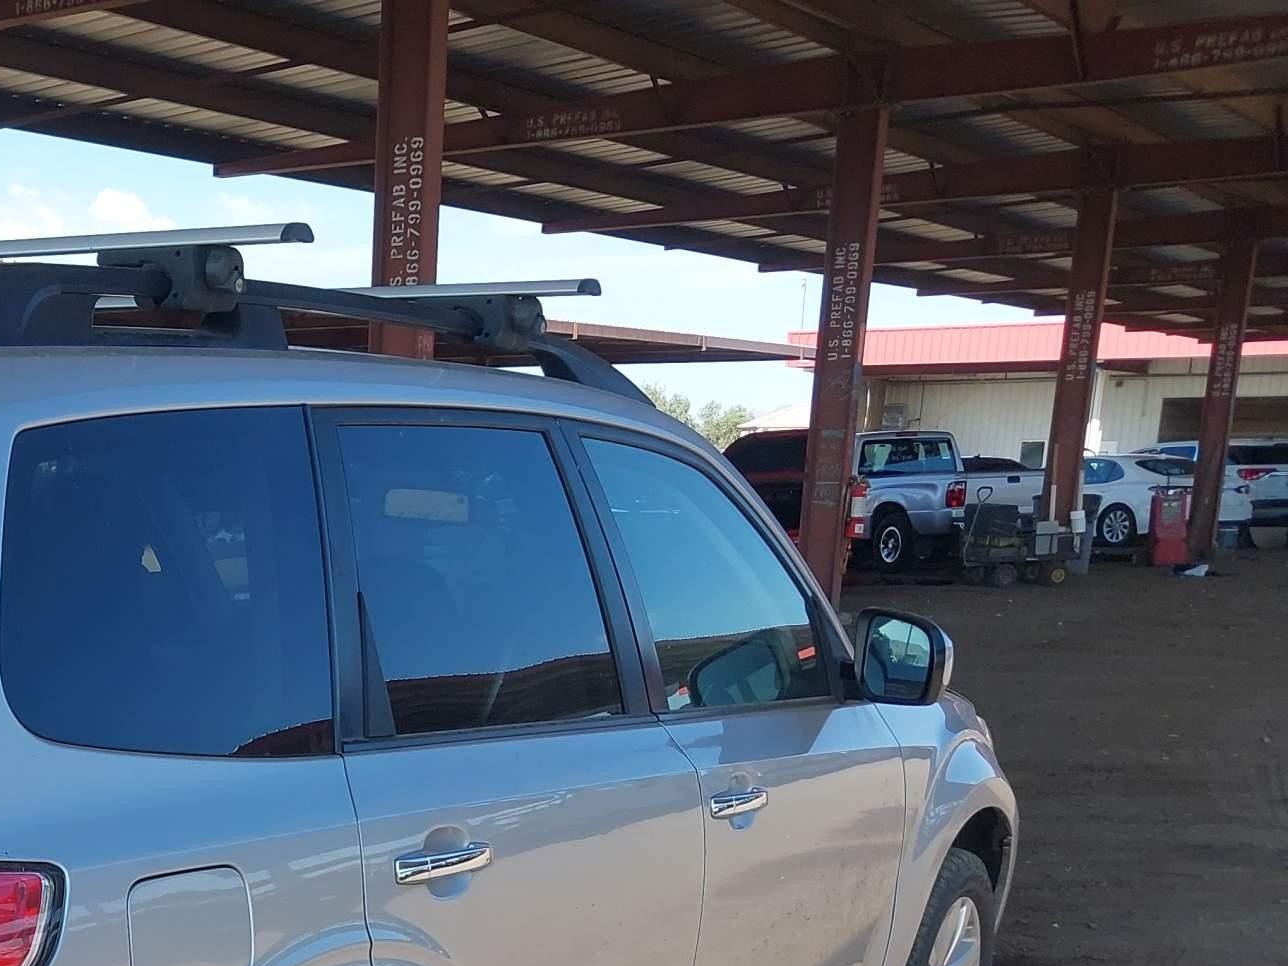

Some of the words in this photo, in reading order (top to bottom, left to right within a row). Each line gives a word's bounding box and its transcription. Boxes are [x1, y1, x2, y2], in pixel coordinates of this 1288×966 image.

[393, 136, 408, 174] INC.
[391, 184, 406, 259] PREFAB
[406, 137, 424, 286] 866-799-0969
[830, 276, 845, 328] PREFAB
[840, 242, 861, 359] 1-866-799-0969
[827, 335, 840, 361] U.S.
